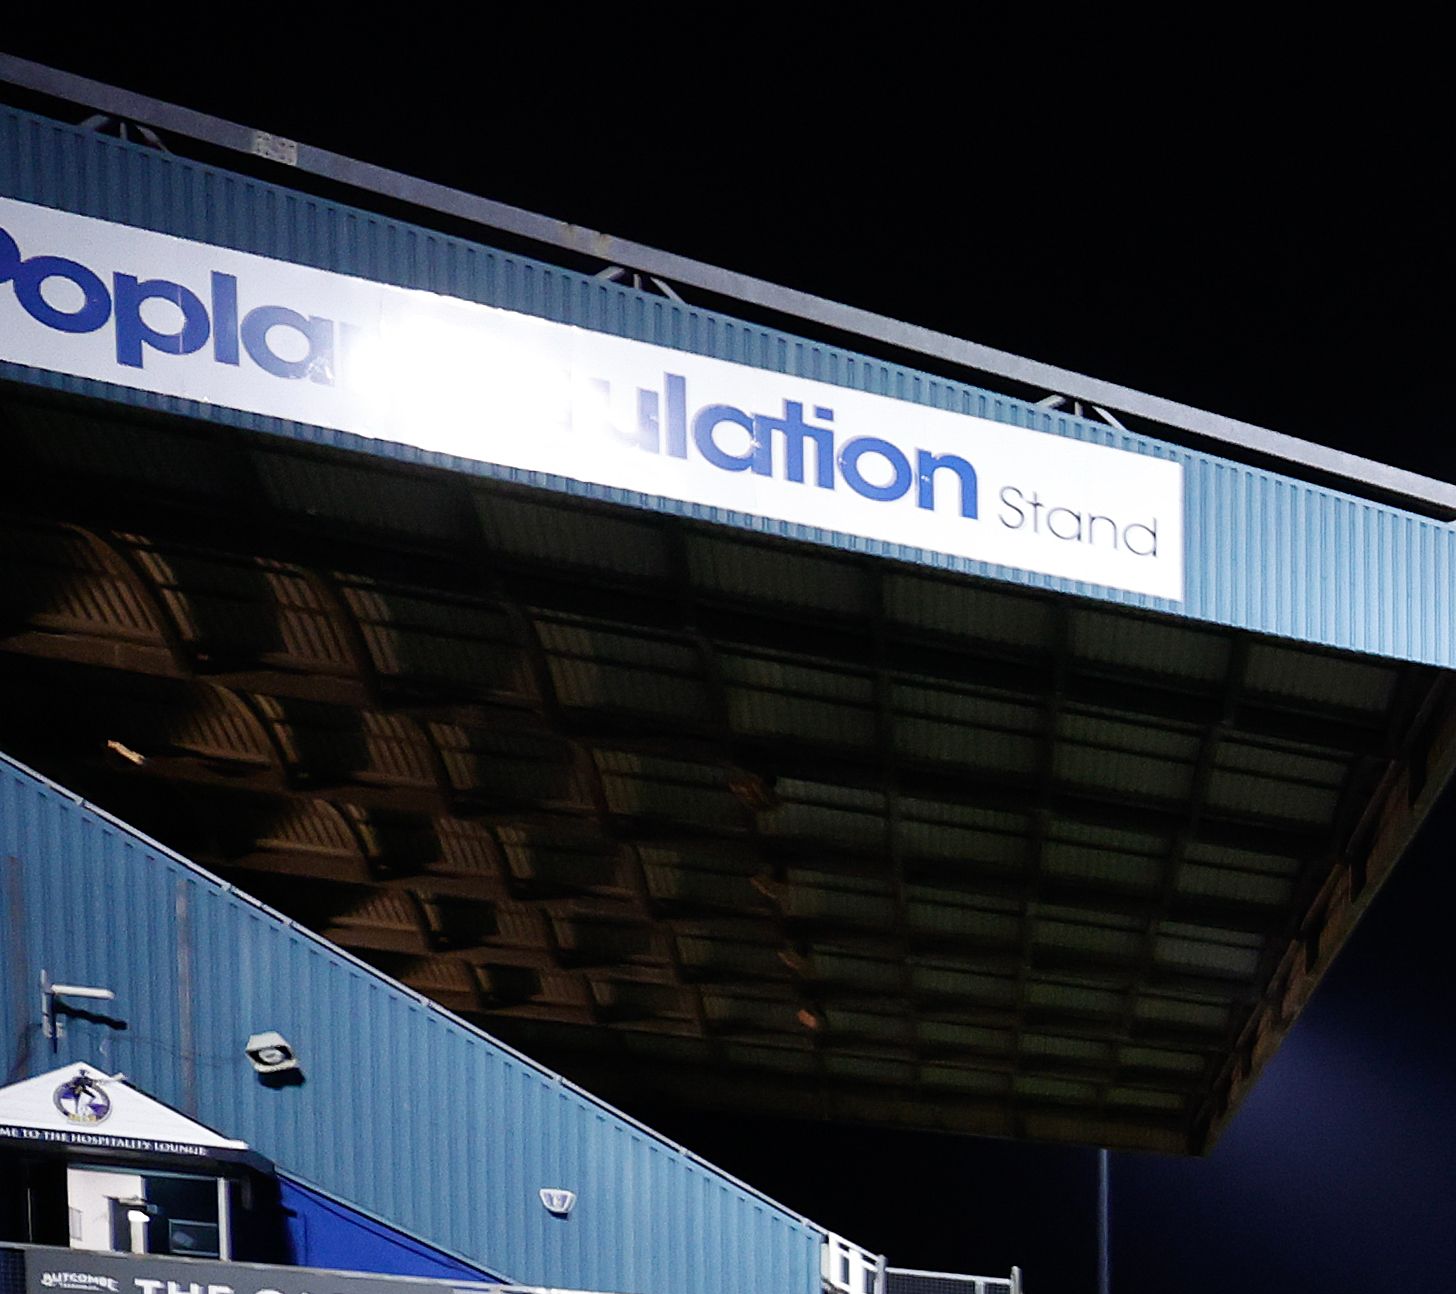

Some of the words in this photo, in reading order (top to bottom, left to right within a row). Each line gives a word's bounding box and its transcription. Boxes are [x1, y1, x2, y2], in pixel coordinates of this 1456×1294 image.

[0, 226, 358, 387] opla
[997, 484, 1158, 558] Stand
[22, 1129, 39, 1139] TO
[44, 1131, 68, 1142] THE
[70, 1133, 151, 1149] HOSPITALITY
[153, 1141, 207, 1156] LOUNGE
